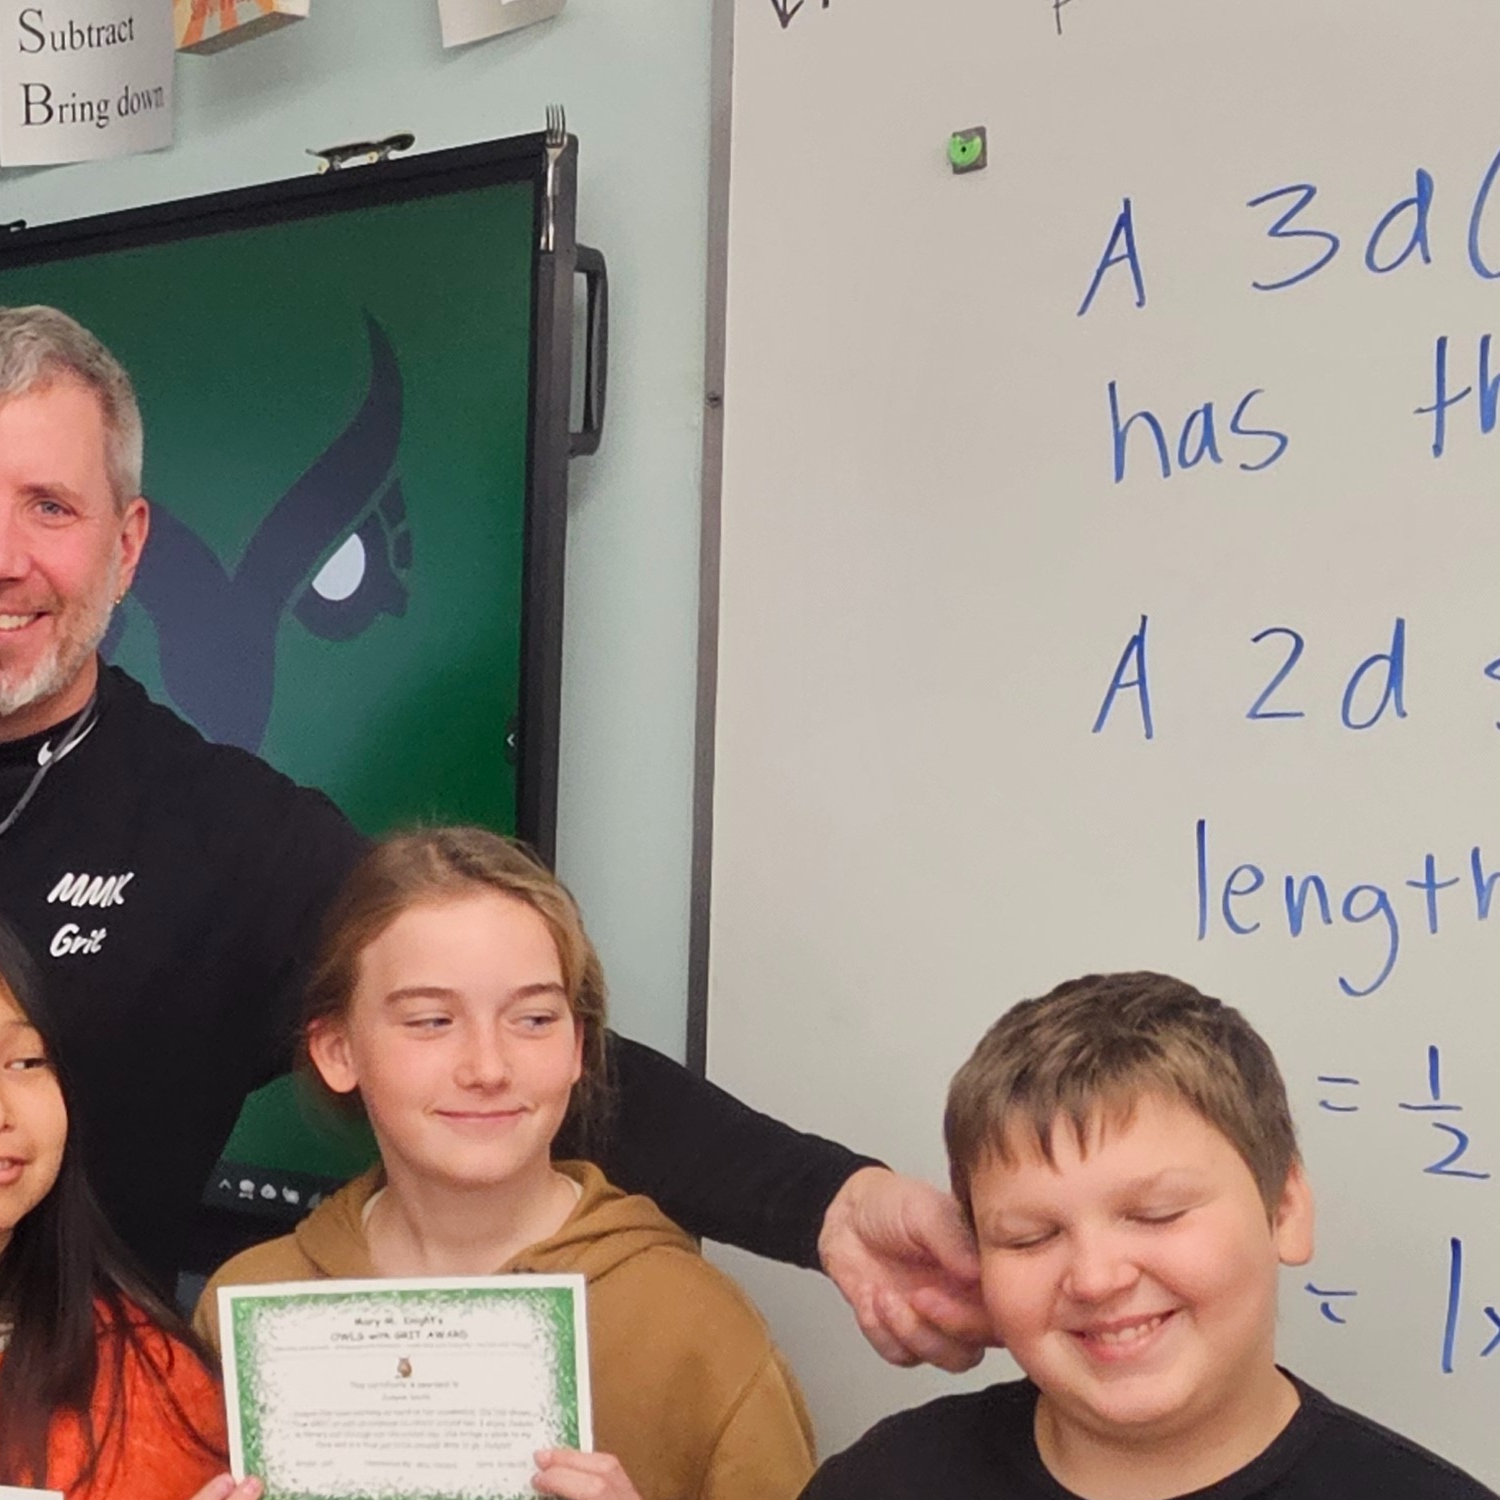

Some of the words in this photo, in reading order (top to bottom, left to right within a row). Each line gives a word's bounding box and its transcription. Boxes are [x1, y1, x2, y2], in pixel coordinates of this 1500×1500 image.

[18, 8, 134, 54] Subtract
[21, 82, 111, 129] Bring
[117, 85, 166, 118] down
[1077, 197, 1147, 316] A
[1107, 380, 1288, 484] has
[1092, 614, 1153, 740] A
[1245, 617, 1408, 730] 2d
[46, 872, 135, 908] MMK
[49, 923, 107, 958] Grit
[329, 1332, 364, 1341] OWLS
[367, 1331, 390, 1341] with
[393, 1330, 421, 1340] GRIT
[426, 1329, 468, 1339] AWARD
